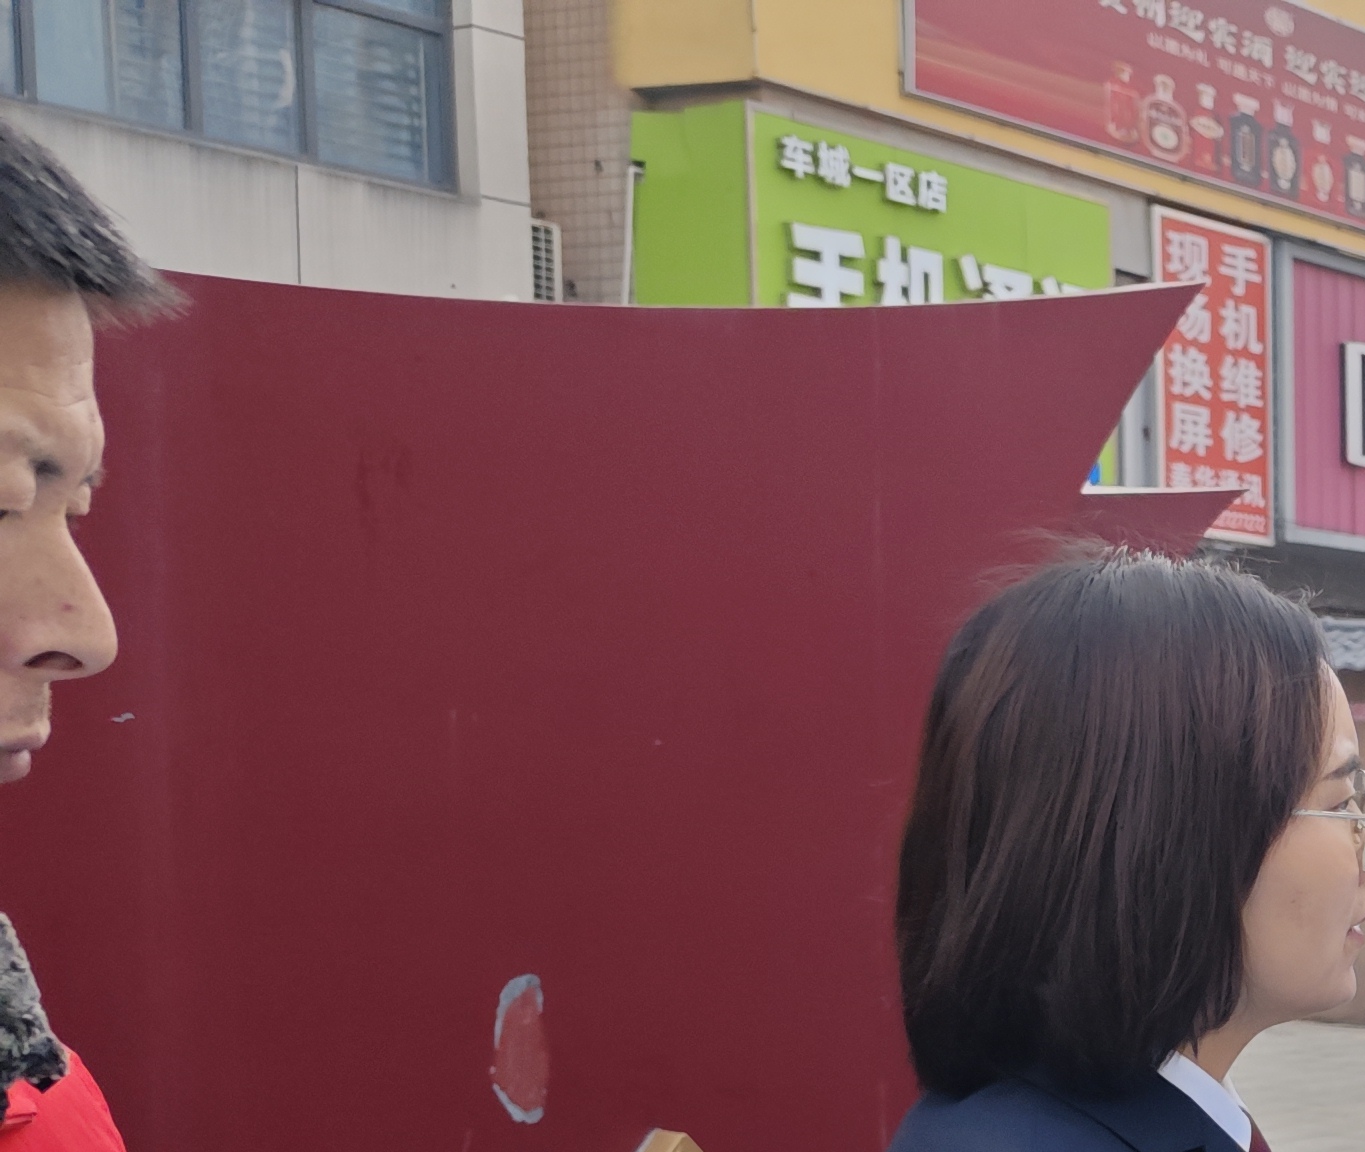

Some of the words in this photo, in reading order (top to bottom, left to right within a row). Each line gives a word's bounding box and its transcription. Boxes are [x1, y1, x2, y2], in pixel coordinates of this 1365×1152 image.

[778, 134, 949, 214] 车城一区店
[1217, 243, 1265, 464] 手机维修
